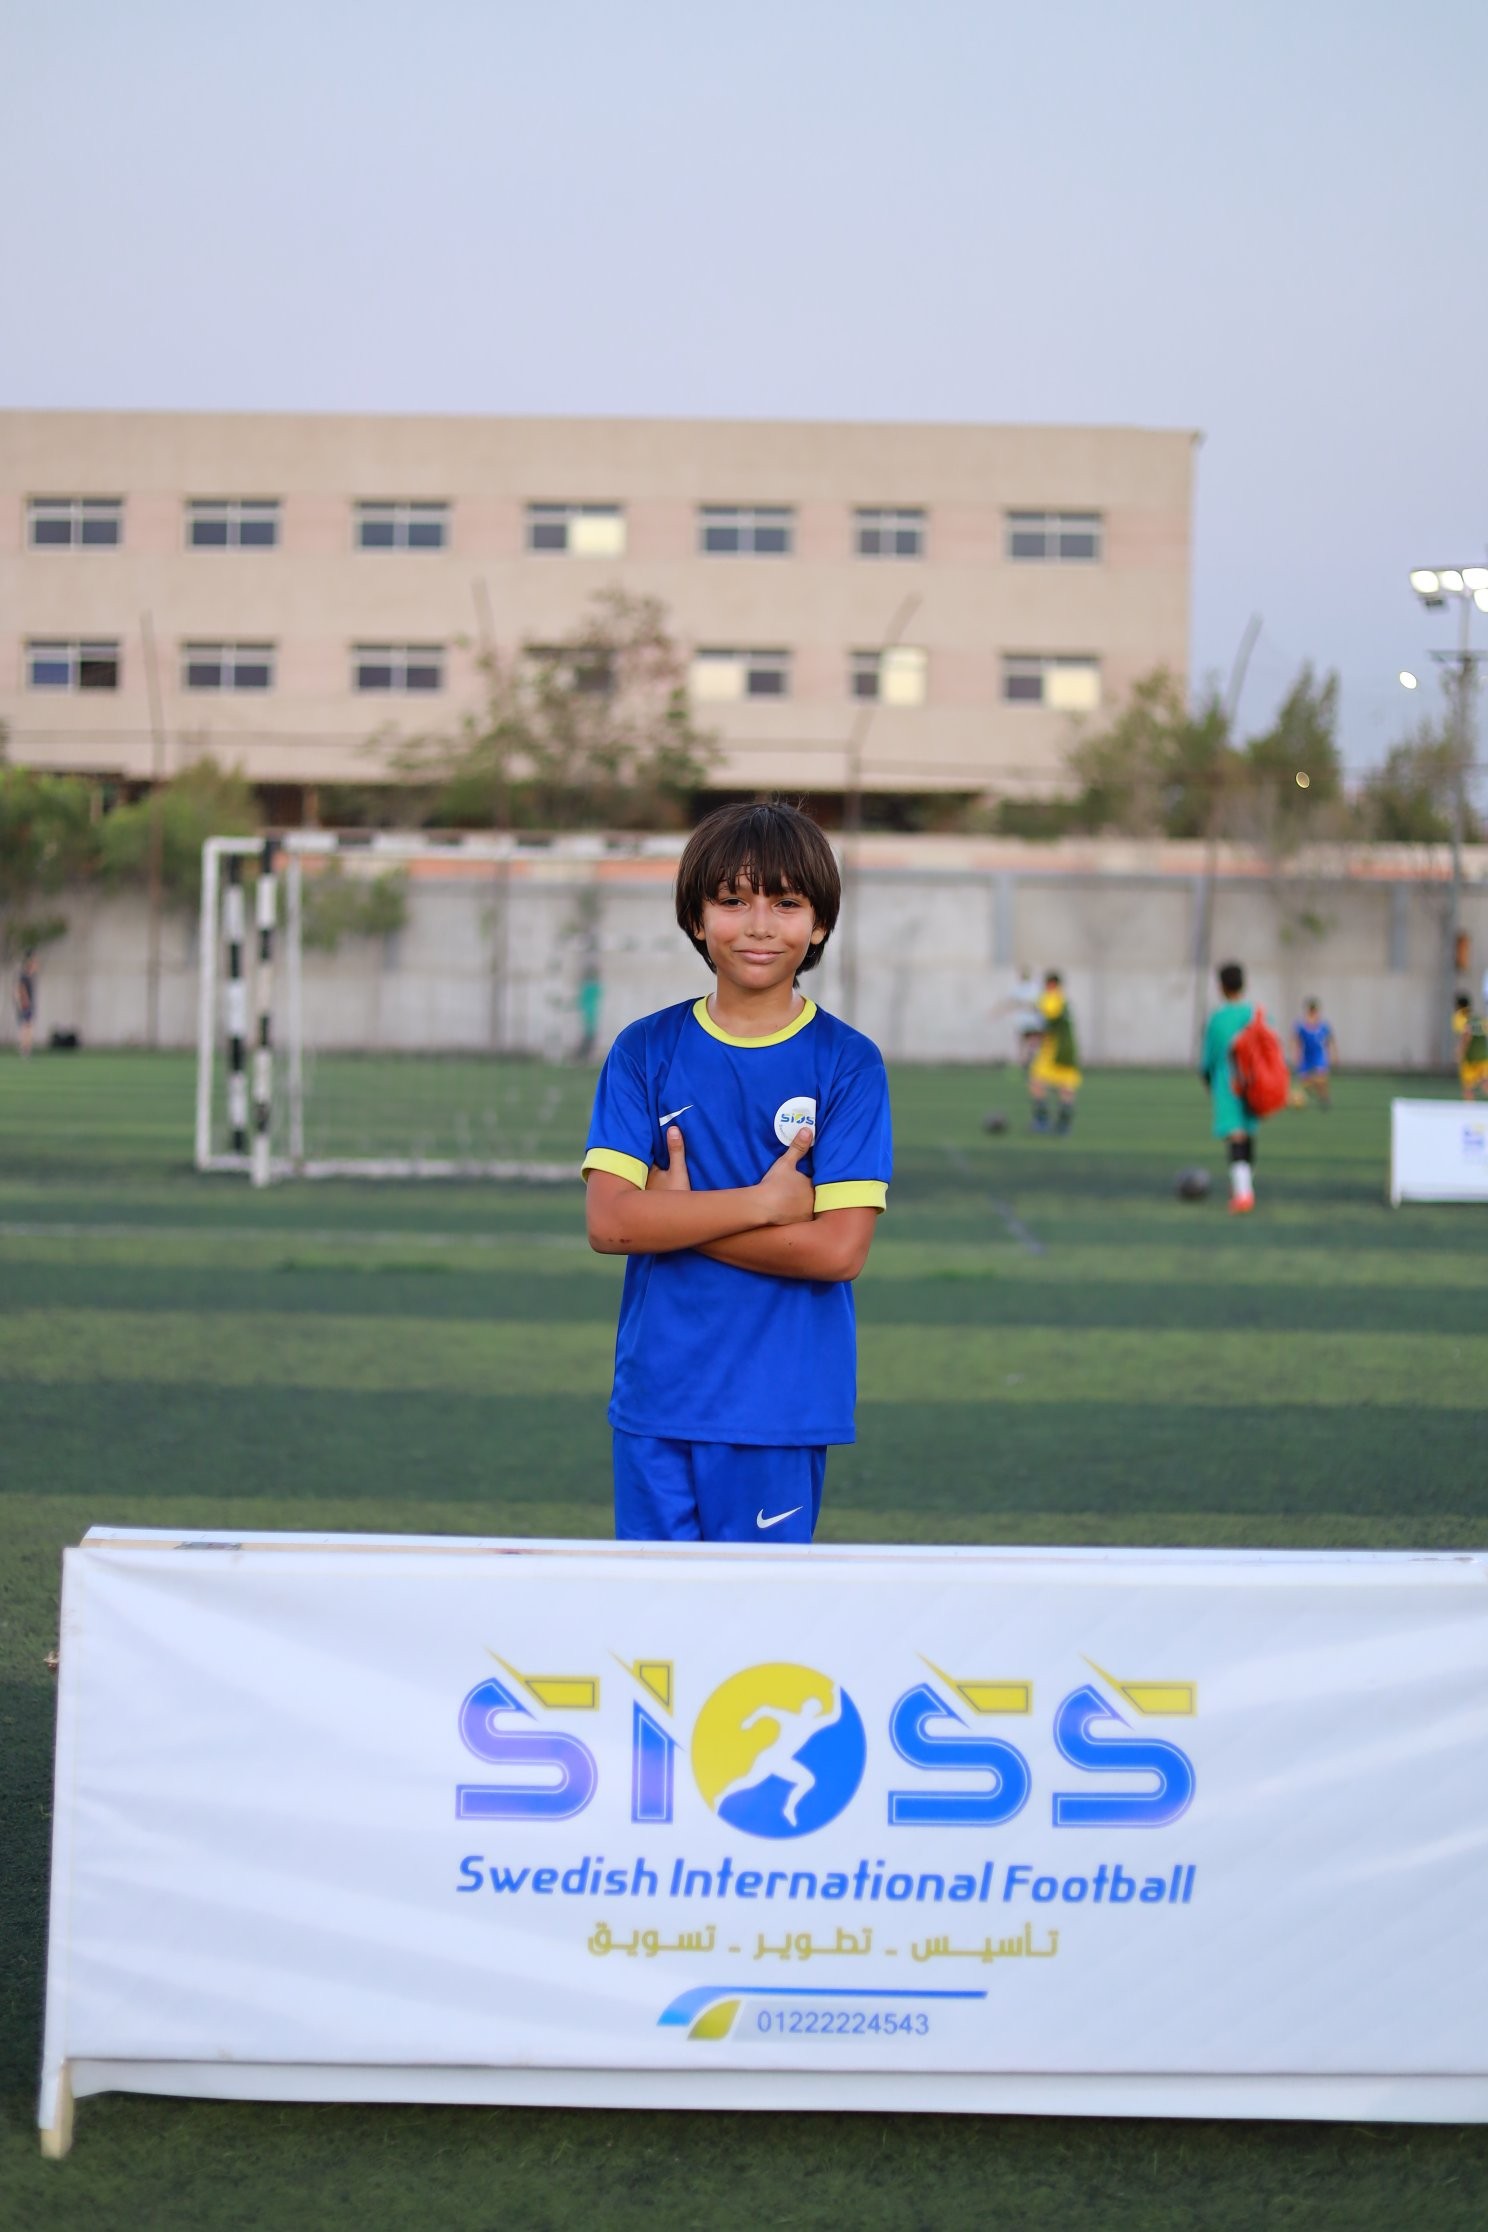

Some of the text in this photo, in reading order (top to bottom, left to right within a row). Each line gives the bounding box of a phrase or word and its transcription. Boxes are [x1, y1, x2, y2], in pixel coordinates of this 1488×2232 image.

[456, 1855, 1197, 1904] Swedish International Football
[586, 1920, 717, 1959] تسويق
[753, 1926, 873, 1962] تطوير
[910, 1921, 1060, 1964] تأسيس
[757, 2010, 929, 2035] 01222224543
